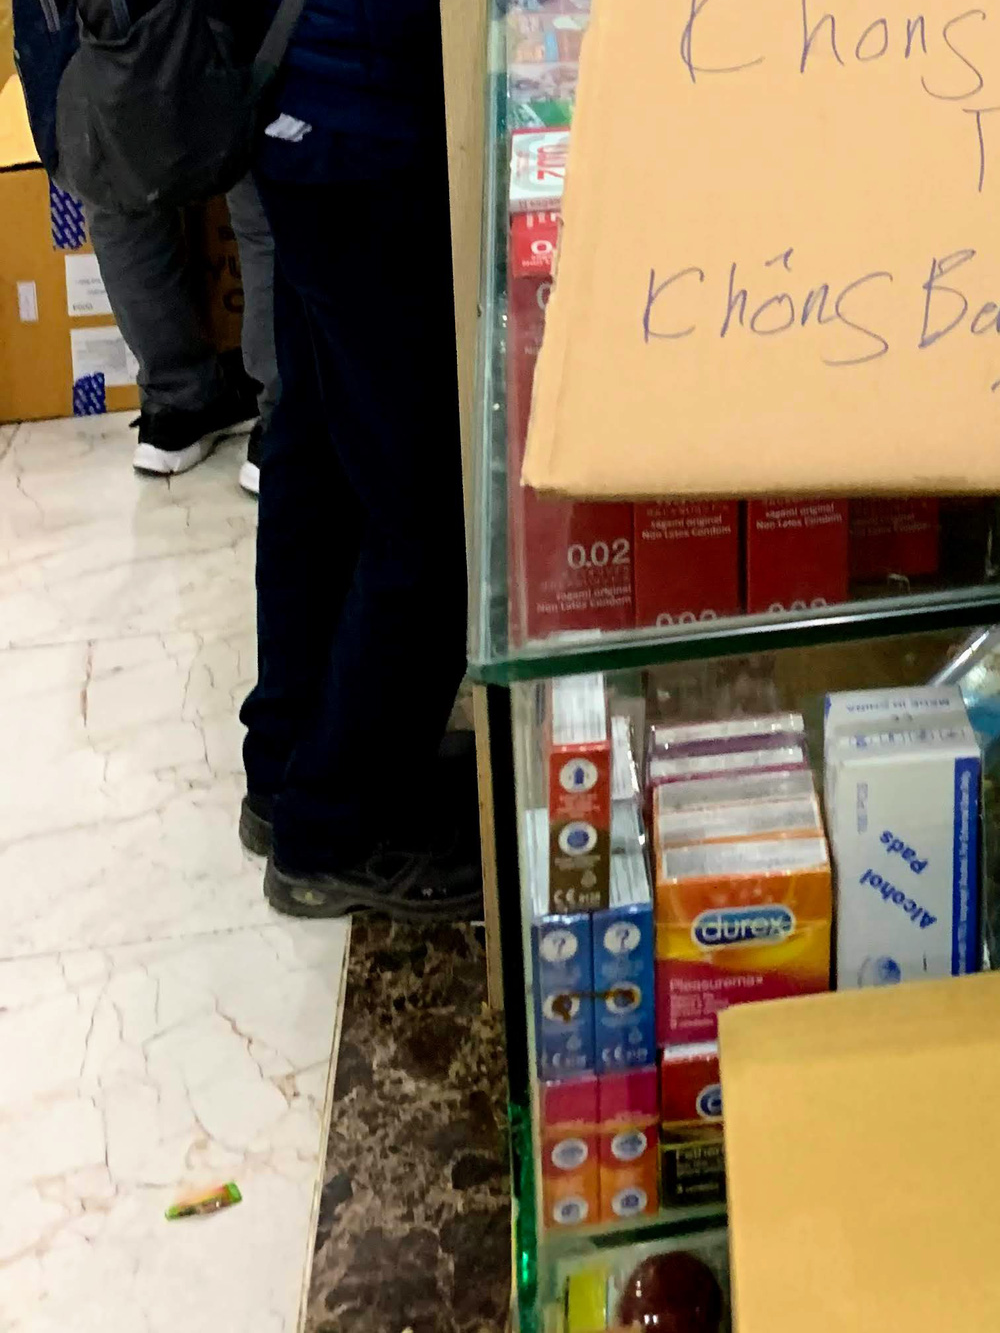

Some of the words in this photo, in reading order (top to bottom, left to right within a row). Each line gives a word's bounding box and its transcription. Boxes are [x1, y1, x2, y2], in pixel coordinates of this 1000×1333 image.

[642, 247, 893, 366] Không
[567, 538, 631, 569] 0.02
[878, 830, 929, 875] Pads
[858, 869, 938, 930] Alcohol
[701, 914, 786, 941] durex
